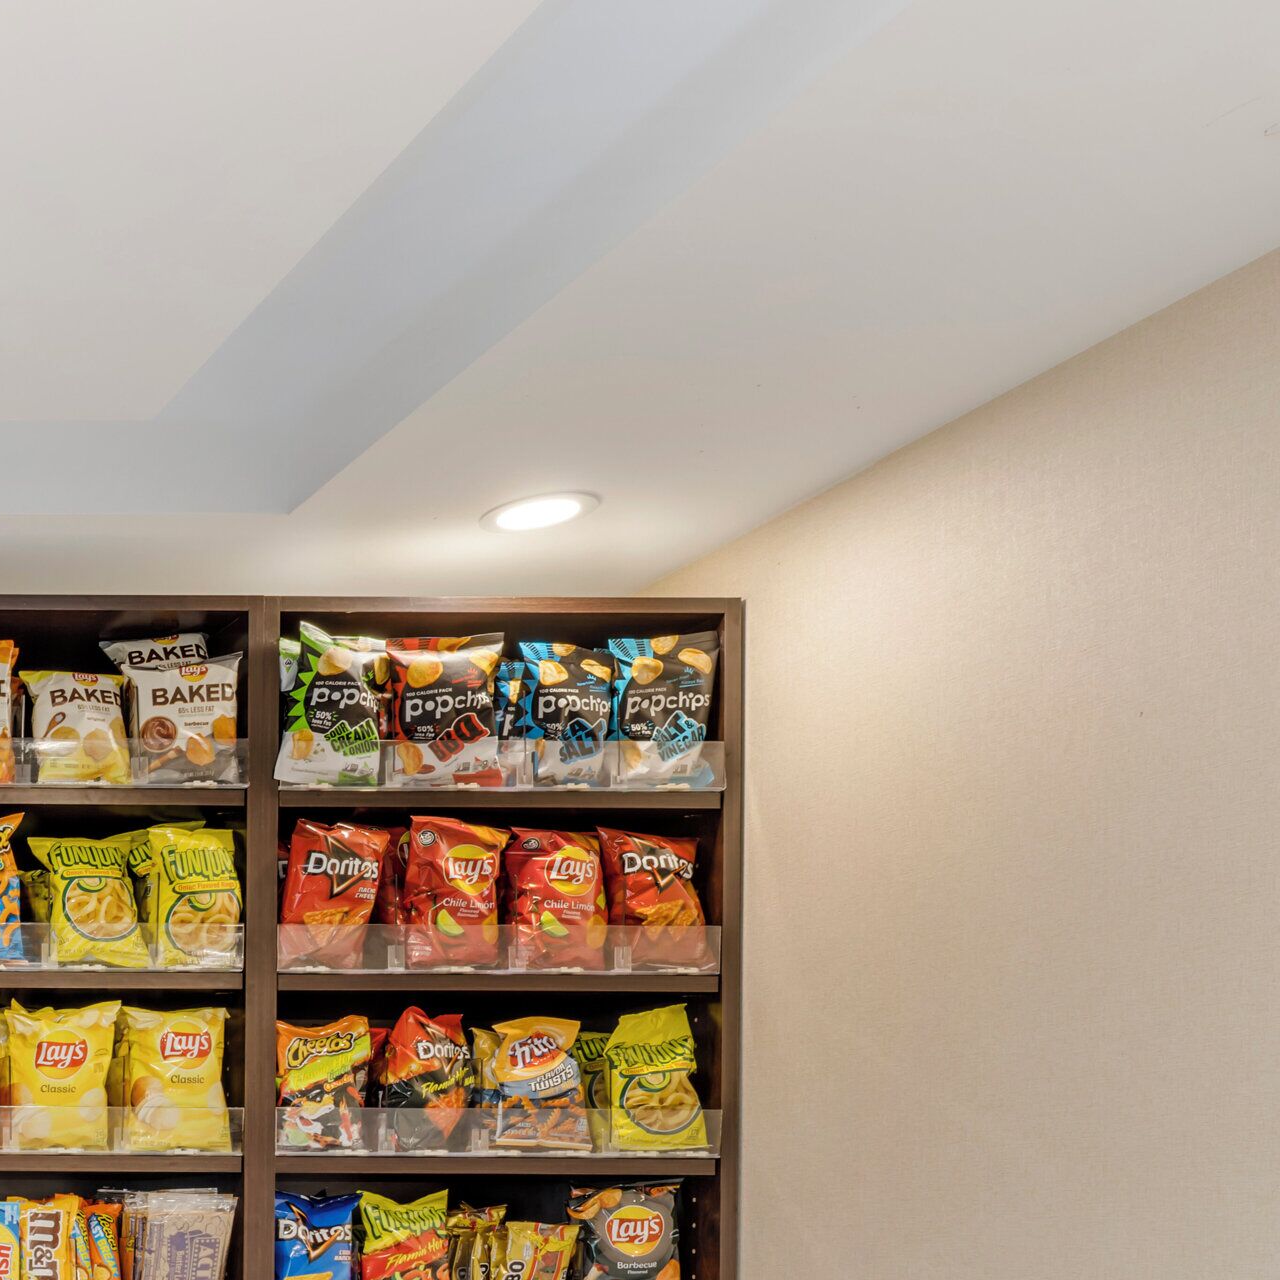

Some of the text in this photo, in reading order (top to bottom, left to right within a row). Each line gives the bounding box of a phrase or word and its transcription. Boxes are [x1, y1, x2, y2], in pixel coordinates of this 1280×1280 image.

[128, 644, 208, 665] BAKED
[152, 683, 234, 706] BAKED
[308, 853, 379, 879] Doritos
[447, 857, 494, 884] Lay's
[550, 857, 594, 885] Lay's
[622, 852, 694, 879] Doritos
[37, 1040, 86, 1069] Lay's
[164, 1031, 210, 1058] Lay's
[287, 1033, 354, 1068] Cheetos
[417, 1042, 471, 1060] Doritos
[40, 1084, 76, 1093] Classic
[170, 1074, 205, 1084] Classic
[278, 1219, 351, 1244] Doritos
[611, 1218, 661, 1244] Lay's
[617, 1261, 657, 1269] Barbecue
